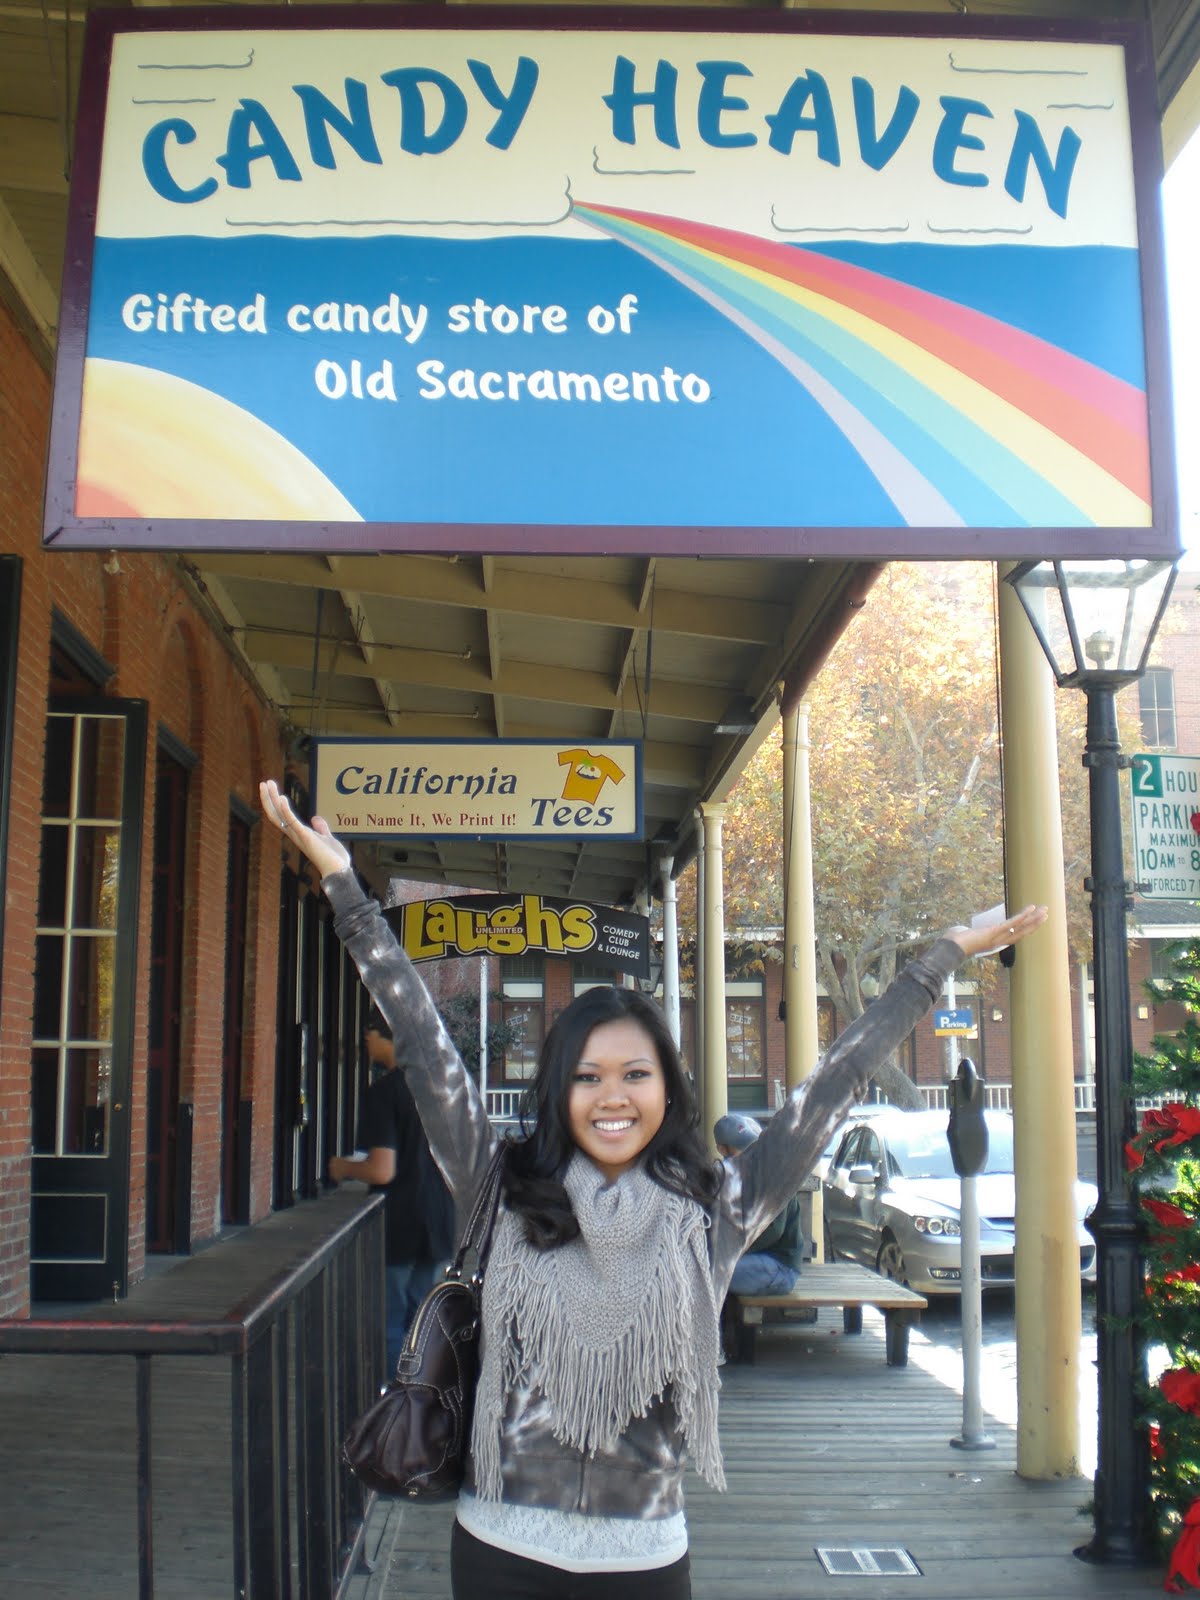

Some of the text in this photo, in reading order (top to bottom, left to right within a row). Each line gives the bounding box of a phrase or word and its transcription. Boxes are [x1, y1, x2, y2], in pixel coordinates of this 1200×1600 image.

[142, 55, 1082, 220] CANDY HEAVEN
[122, 292, 639, 344] Gifted candy store of
[314, 358, 711, 403] Old Sacramento
[335, 766, 518, 801] California
[1139, 759, 1154, 791] 2
[335, 813, 517, 828] You Name It, We Print It!
[530, 797, 615, 828] Tees
[1150, 832, 1200, 848] MAXIMU
[402, 895, 597, 962] Laughs
[475, 926, 523, 934] UNLIMITED
[602, 925, 640, 940] COMEDY
[597, 943, 640, 960] & LOUNGE
[608, 935, 630, 947] CLUB
[940, 1016, 967, 1028] Parking
